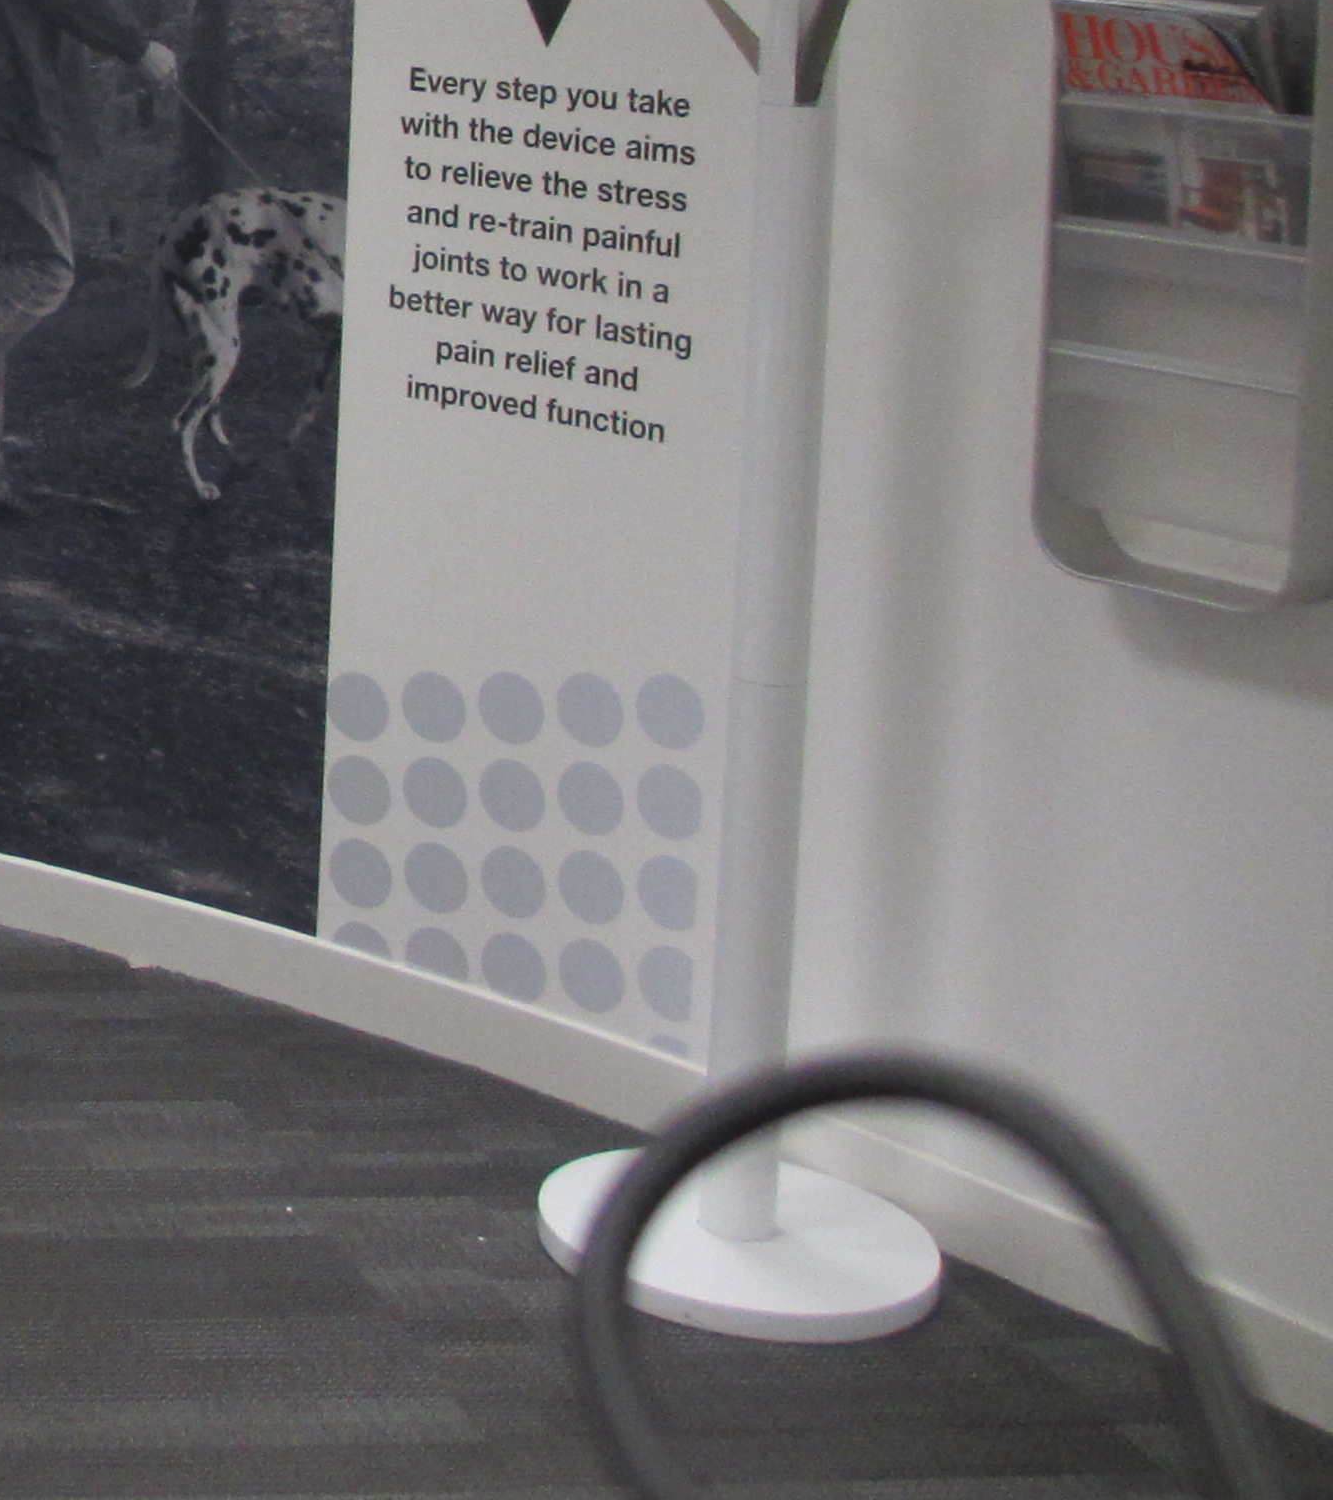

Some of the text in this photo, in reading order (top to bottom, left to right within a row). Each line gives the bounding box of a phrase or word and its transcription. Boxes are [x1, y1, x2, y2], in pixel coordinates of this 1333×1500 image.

[410, 67, 690, 118] Every step you take
[401, 113, 695, 165] with the device aims
[405, 156, 687, 212] to relieve the stress
[407, 204, 680, 258] and re-train painful
[413, 244, 669, 303] joints to work in a
[389, 284, 692, 360] better way for lasting
[436, 340, 638, 391] pain relief and
[407, 375, 665, 443] improved function
